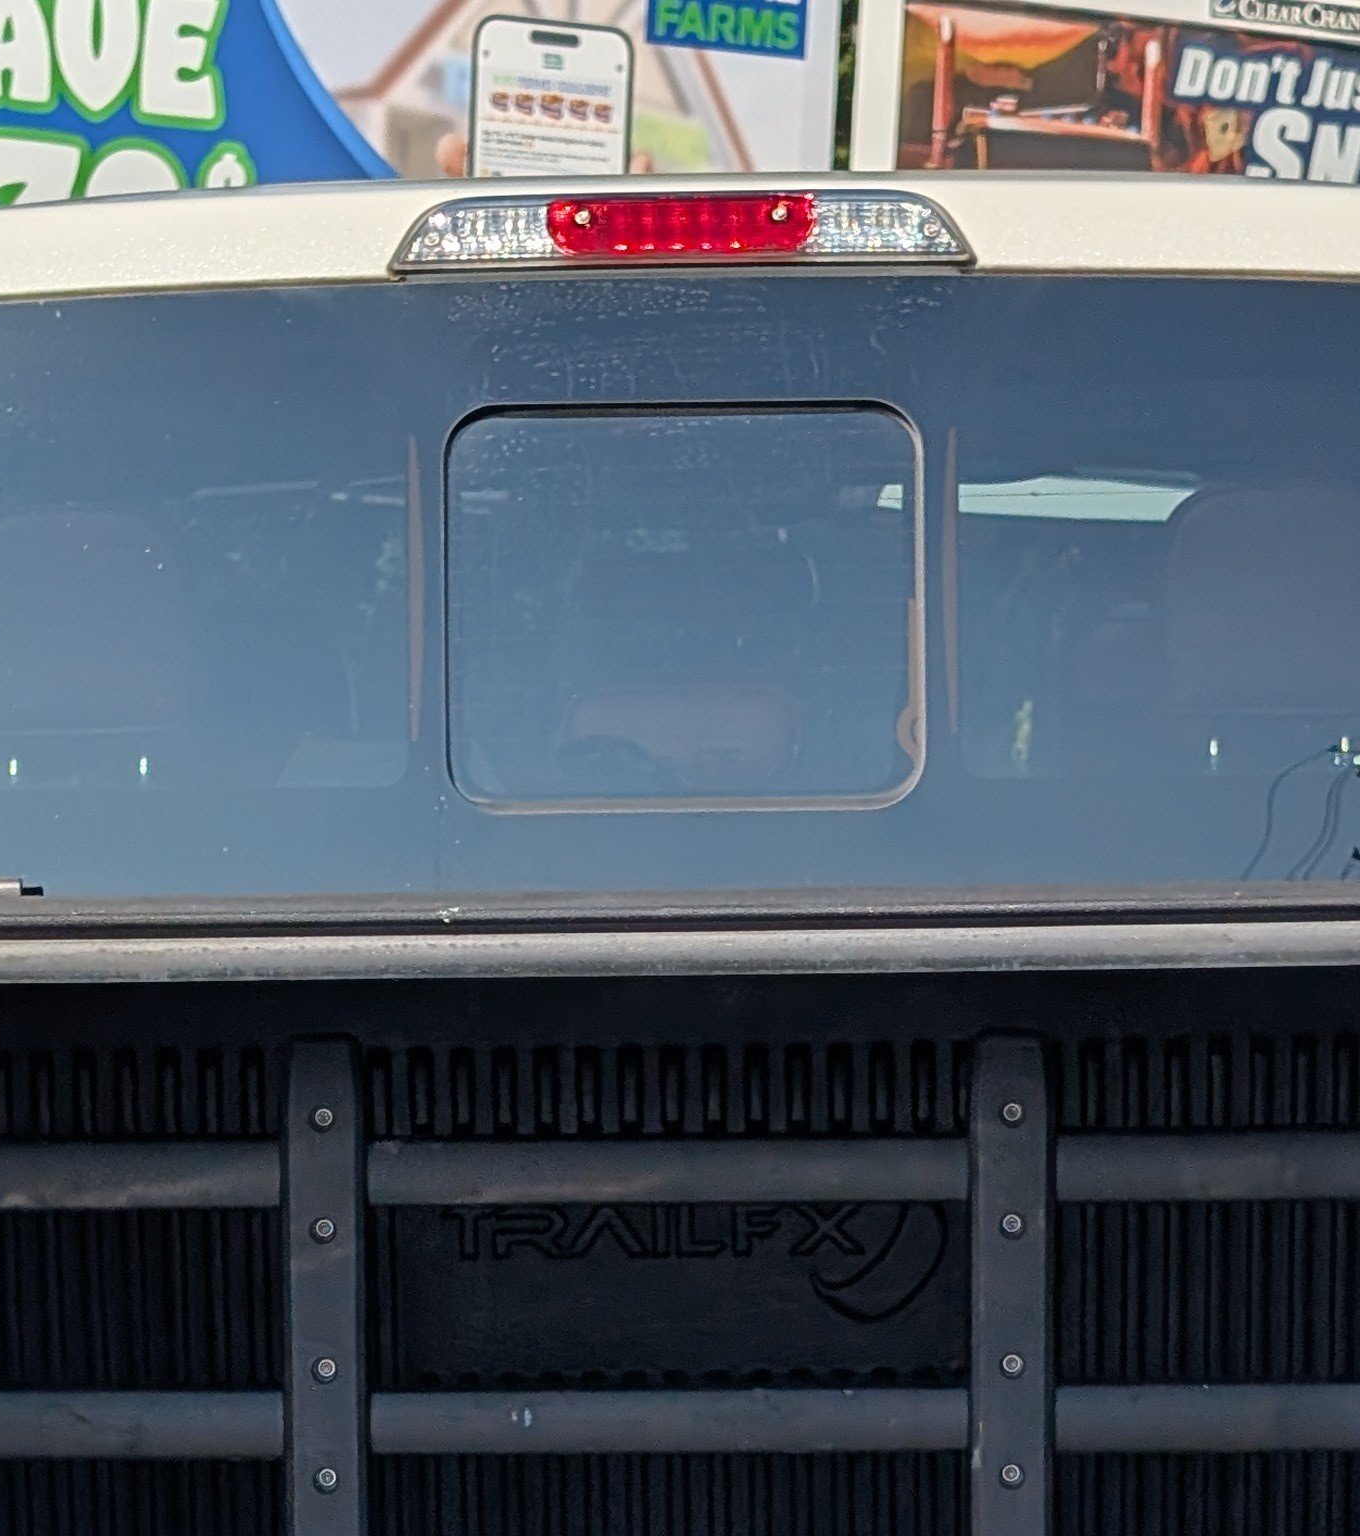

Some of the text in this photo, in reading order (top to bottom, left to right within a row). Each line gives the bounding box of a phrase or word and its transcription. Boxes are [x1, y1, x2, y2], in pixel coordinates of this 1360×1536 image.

[654, 0, 799, 50] FARMS
[1173, 46, 1302, 105] Don't
[443, 1200, 868, 1261] TRAILFX
